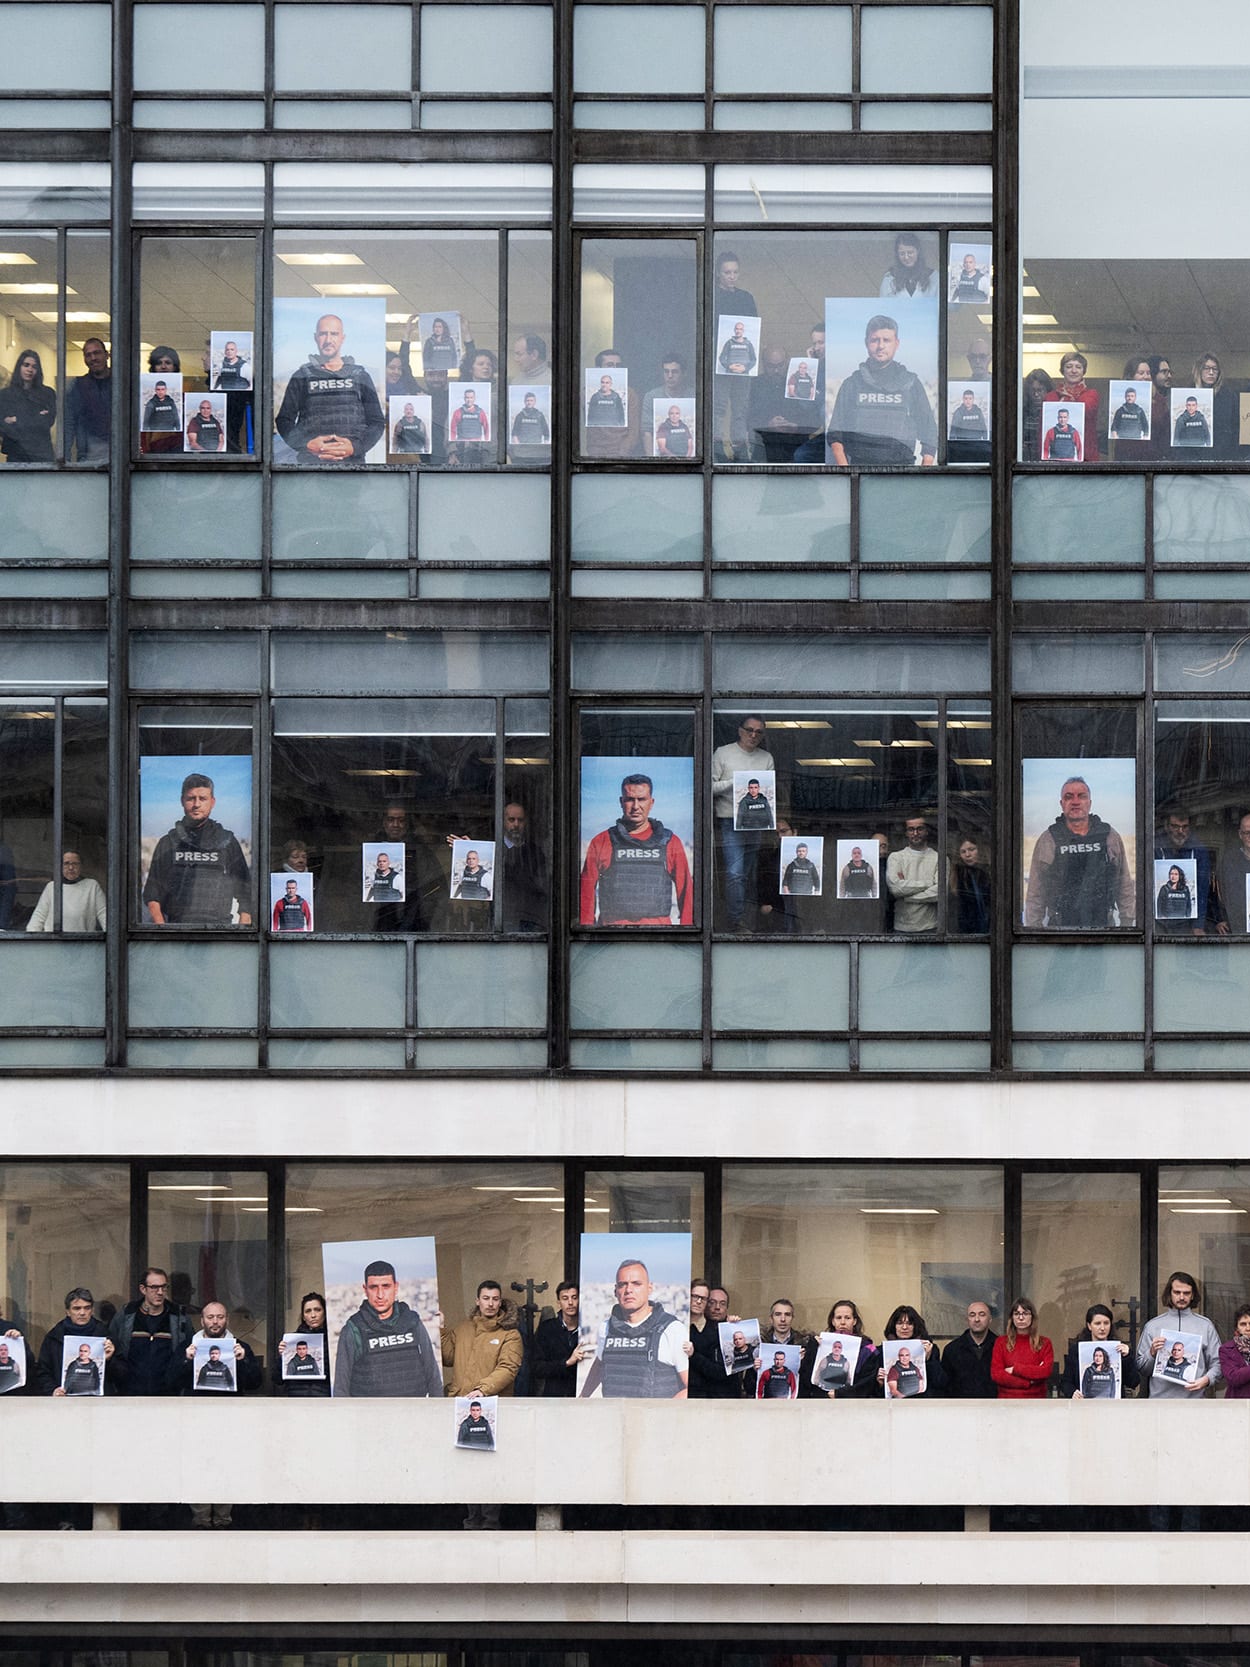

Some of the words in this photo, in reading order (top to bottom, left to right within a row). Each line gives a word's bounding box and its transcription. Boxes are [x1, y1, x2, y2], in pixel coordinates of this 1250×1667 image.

[310, 378, 354, 390] PRESS
[859, 393, 902, 403] PRESS
[617, 849, 660, 858] PRESS
[1060, 843, 1101, 854] PRESS
[175, 852, 218, 862] PRESS
[369, 1333, 414, 1349] PRESS
[606, 1337, 646, 1348] PRESS
